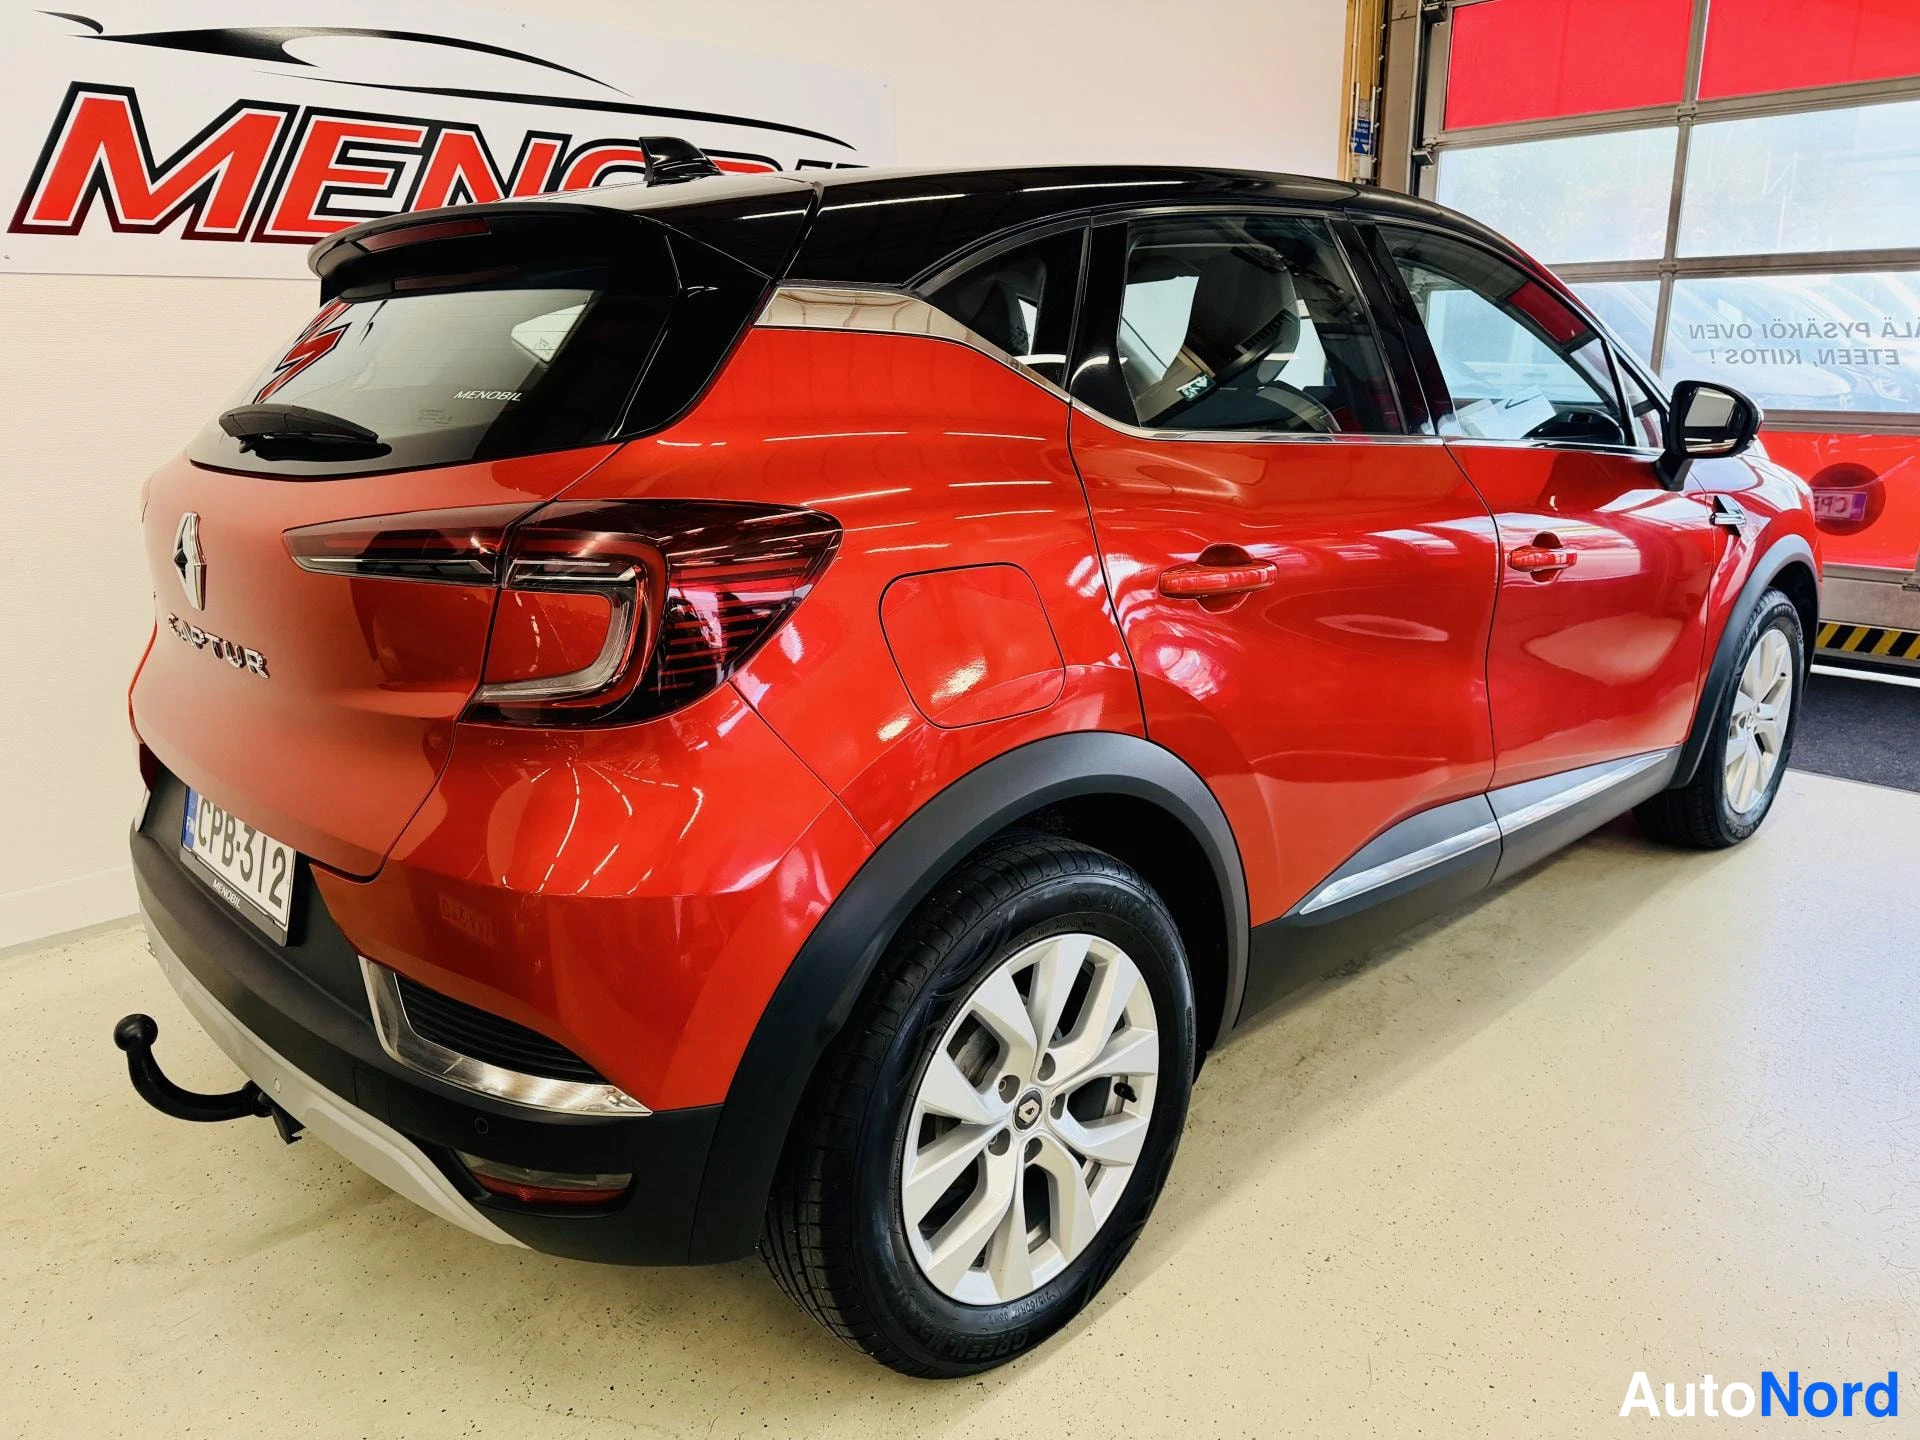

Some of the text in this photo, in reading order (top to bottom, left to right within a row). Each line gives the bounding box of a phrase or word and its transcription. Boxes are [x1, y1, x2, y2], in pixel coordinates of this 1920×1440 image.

[453, 390, 523, 402] MENOBIL
[168, 612, 270, 679] CAPTUR
[198, 797, 287, 910] CPB-312
[212, 878, 241, 909] MENOBIL
